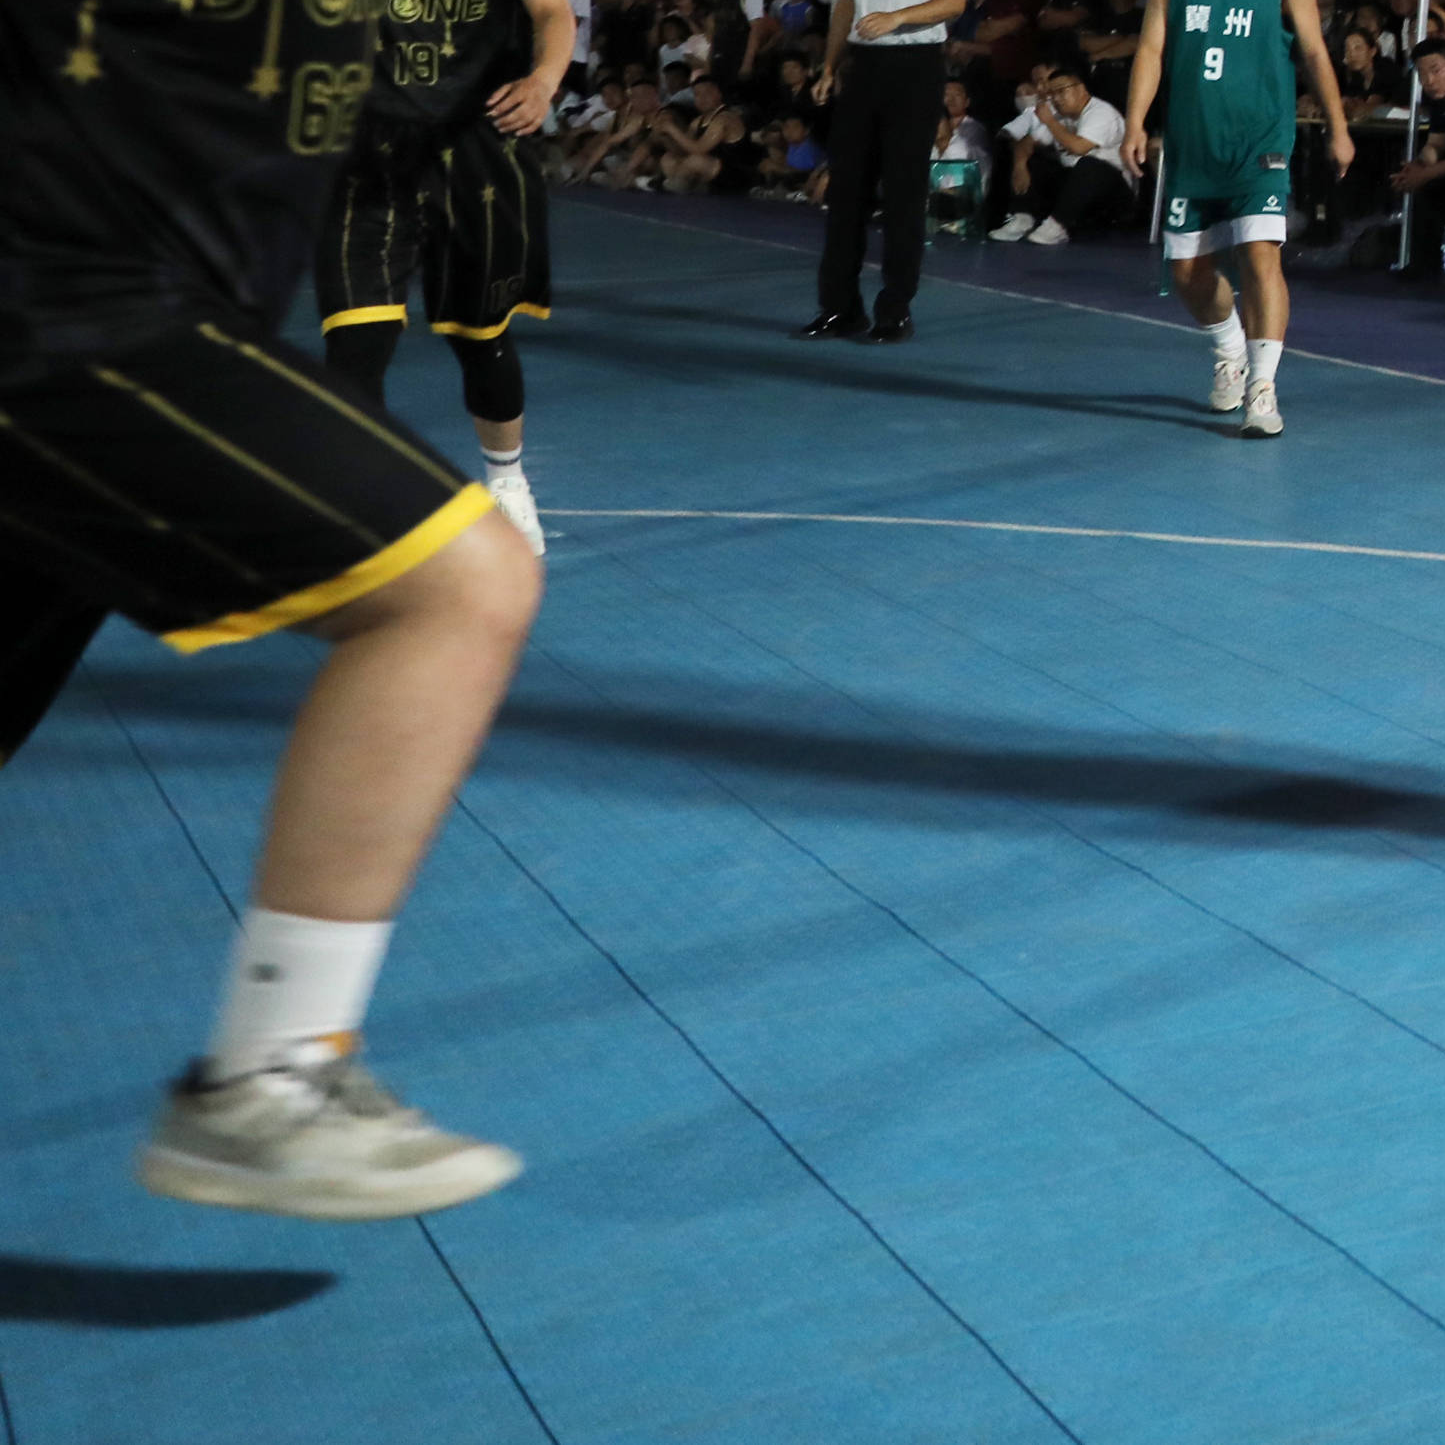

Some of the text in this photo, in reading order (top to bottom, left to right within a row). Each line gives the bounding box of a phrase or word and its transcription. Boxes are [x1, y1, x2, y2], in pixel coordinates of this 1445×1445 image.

[394, 42, 439, 85] 19
[1203, 47, 1224, 82] 9
[1168, 197, 1188, 228] 9
